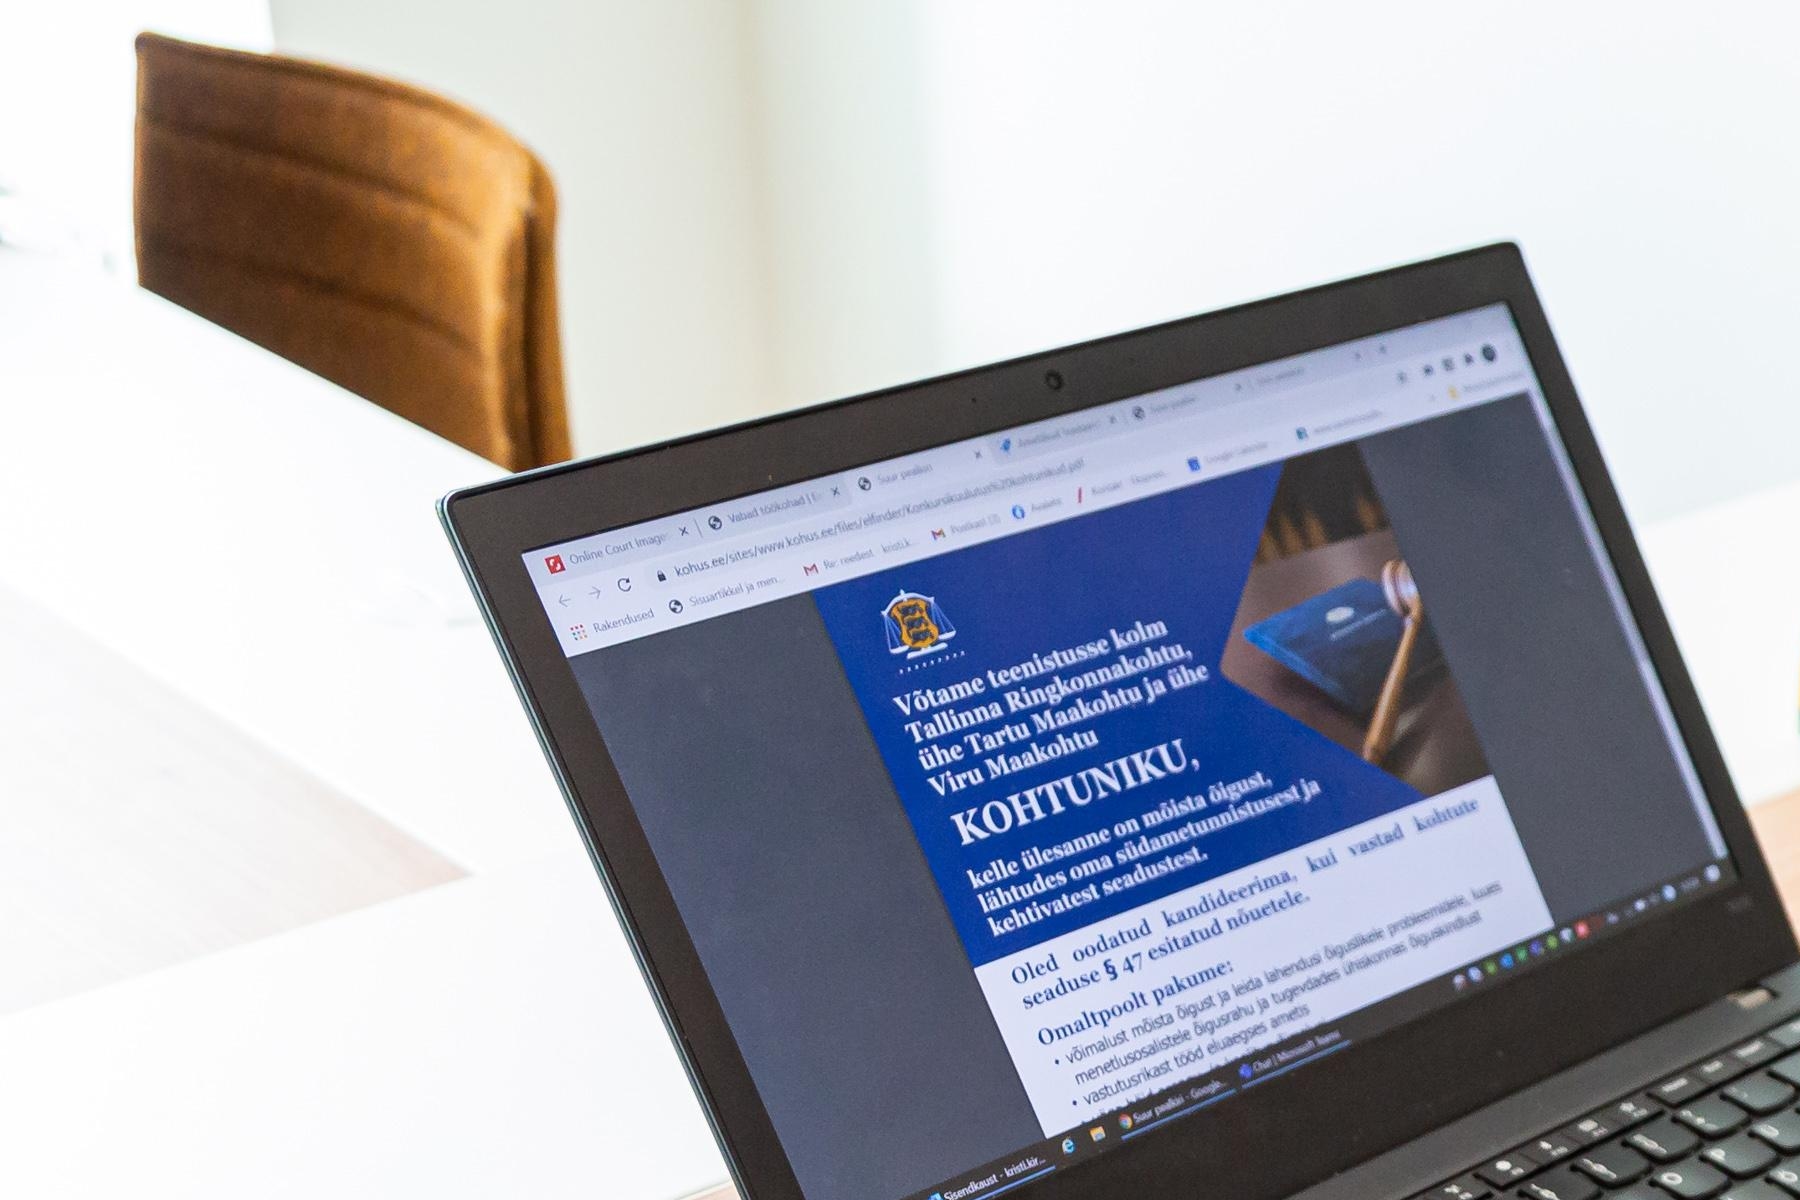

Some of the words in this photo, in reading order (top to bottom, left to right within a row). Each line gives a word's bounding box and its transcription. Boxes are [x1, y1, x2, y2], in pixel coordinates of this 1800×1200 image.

[568, 549, 603, 565] Online
[600, 540, 634, 555] Court
[592, 607, 655, 633] Rakendused
[893, 677, 985, 715] Võtame
[987, 639, 1109, 687] teenistusse
[1109, 620, 1168, 649] kolm
[904, 702, 1003, 743] Tallinna
[1005, 645, 1191, 712] Ringkonnakohtu,
[918, 744, 964, 770] ühe
[963, 722, 1031, 754] Tartu
[1031, 686, 1142, 733] Maakohtu
[1142, 676, 1167, 703] ja
[1167, 664, 1208, 689] ühe
[927, 767, 984, 796] Viru
[985, 730, 1098, 778] Maakohtu
[950, 740, 1198, 844] KOHTUNIKU,
[966, 859, 1019, 889] kelle
[1021, 829, 1110, 870] ülesanne
[1113, 818, 1140, 837] on
[1142, 795, 1207, 827] mõista
[1208, 771, 1272, 807] õigust,
[977, 871, 1067, 913] lähtudes
[1069, 855, 1114, 880] oma
[1116, 786, 1299, 863] südametunnistusest
[1299, 778, 1321, 802] ja
[987, 884, 1099, 936] kehtivatest
[1102, 846, 1207, 895] seadustest.
[1011, 953, 1059, 984] Oled
[1072, 918, 1152, 962] oodatud
[1162, 872, 1296, 927] kandideerima,
[1305, 848, 1338, 873] kui
[1348, 823, 1404, 856] vastad
[1413, 800, 1477, 832] kohtute
[1022, 970, 1099, 1009] seaduse
[1102, 958, 1118, 981] §
[1122, 951, 1142, 973] 47
[1147, 918, 1230, 960] esitatud
[1229, 891, 1309, 928] nõuetele.
[1037, 991, 1148, 1045] Omaltpoolt
[1152, 961, 1233, 1006] pakume:
[1065, 1029, 1129, 1064] võimalust
[1131, 1012, 1175, 1038] mõista
[1175, 994, 1216, 1020] õigust
[1216, 990, 1231, 1007] ja
[1231, 977, 1263, 997] leida
[1075, 1029, 1191, 1084] menetlusosalistele
[1192, 1005, 1255, 1036] õigusrahu
[1255, 997, 1270, 1015] ja
[1270, 969, 1341, 1004] tugevdades
[1083, 1060, 1172, 1104] vastutusrikast
[1173, 1045, 1204, 1068] tööd
[1206, 1022, 1268, 1055] eluaegses
[1660, 1171, 1683, 1186] O
[1709, 1148, 1726, 1162] P
